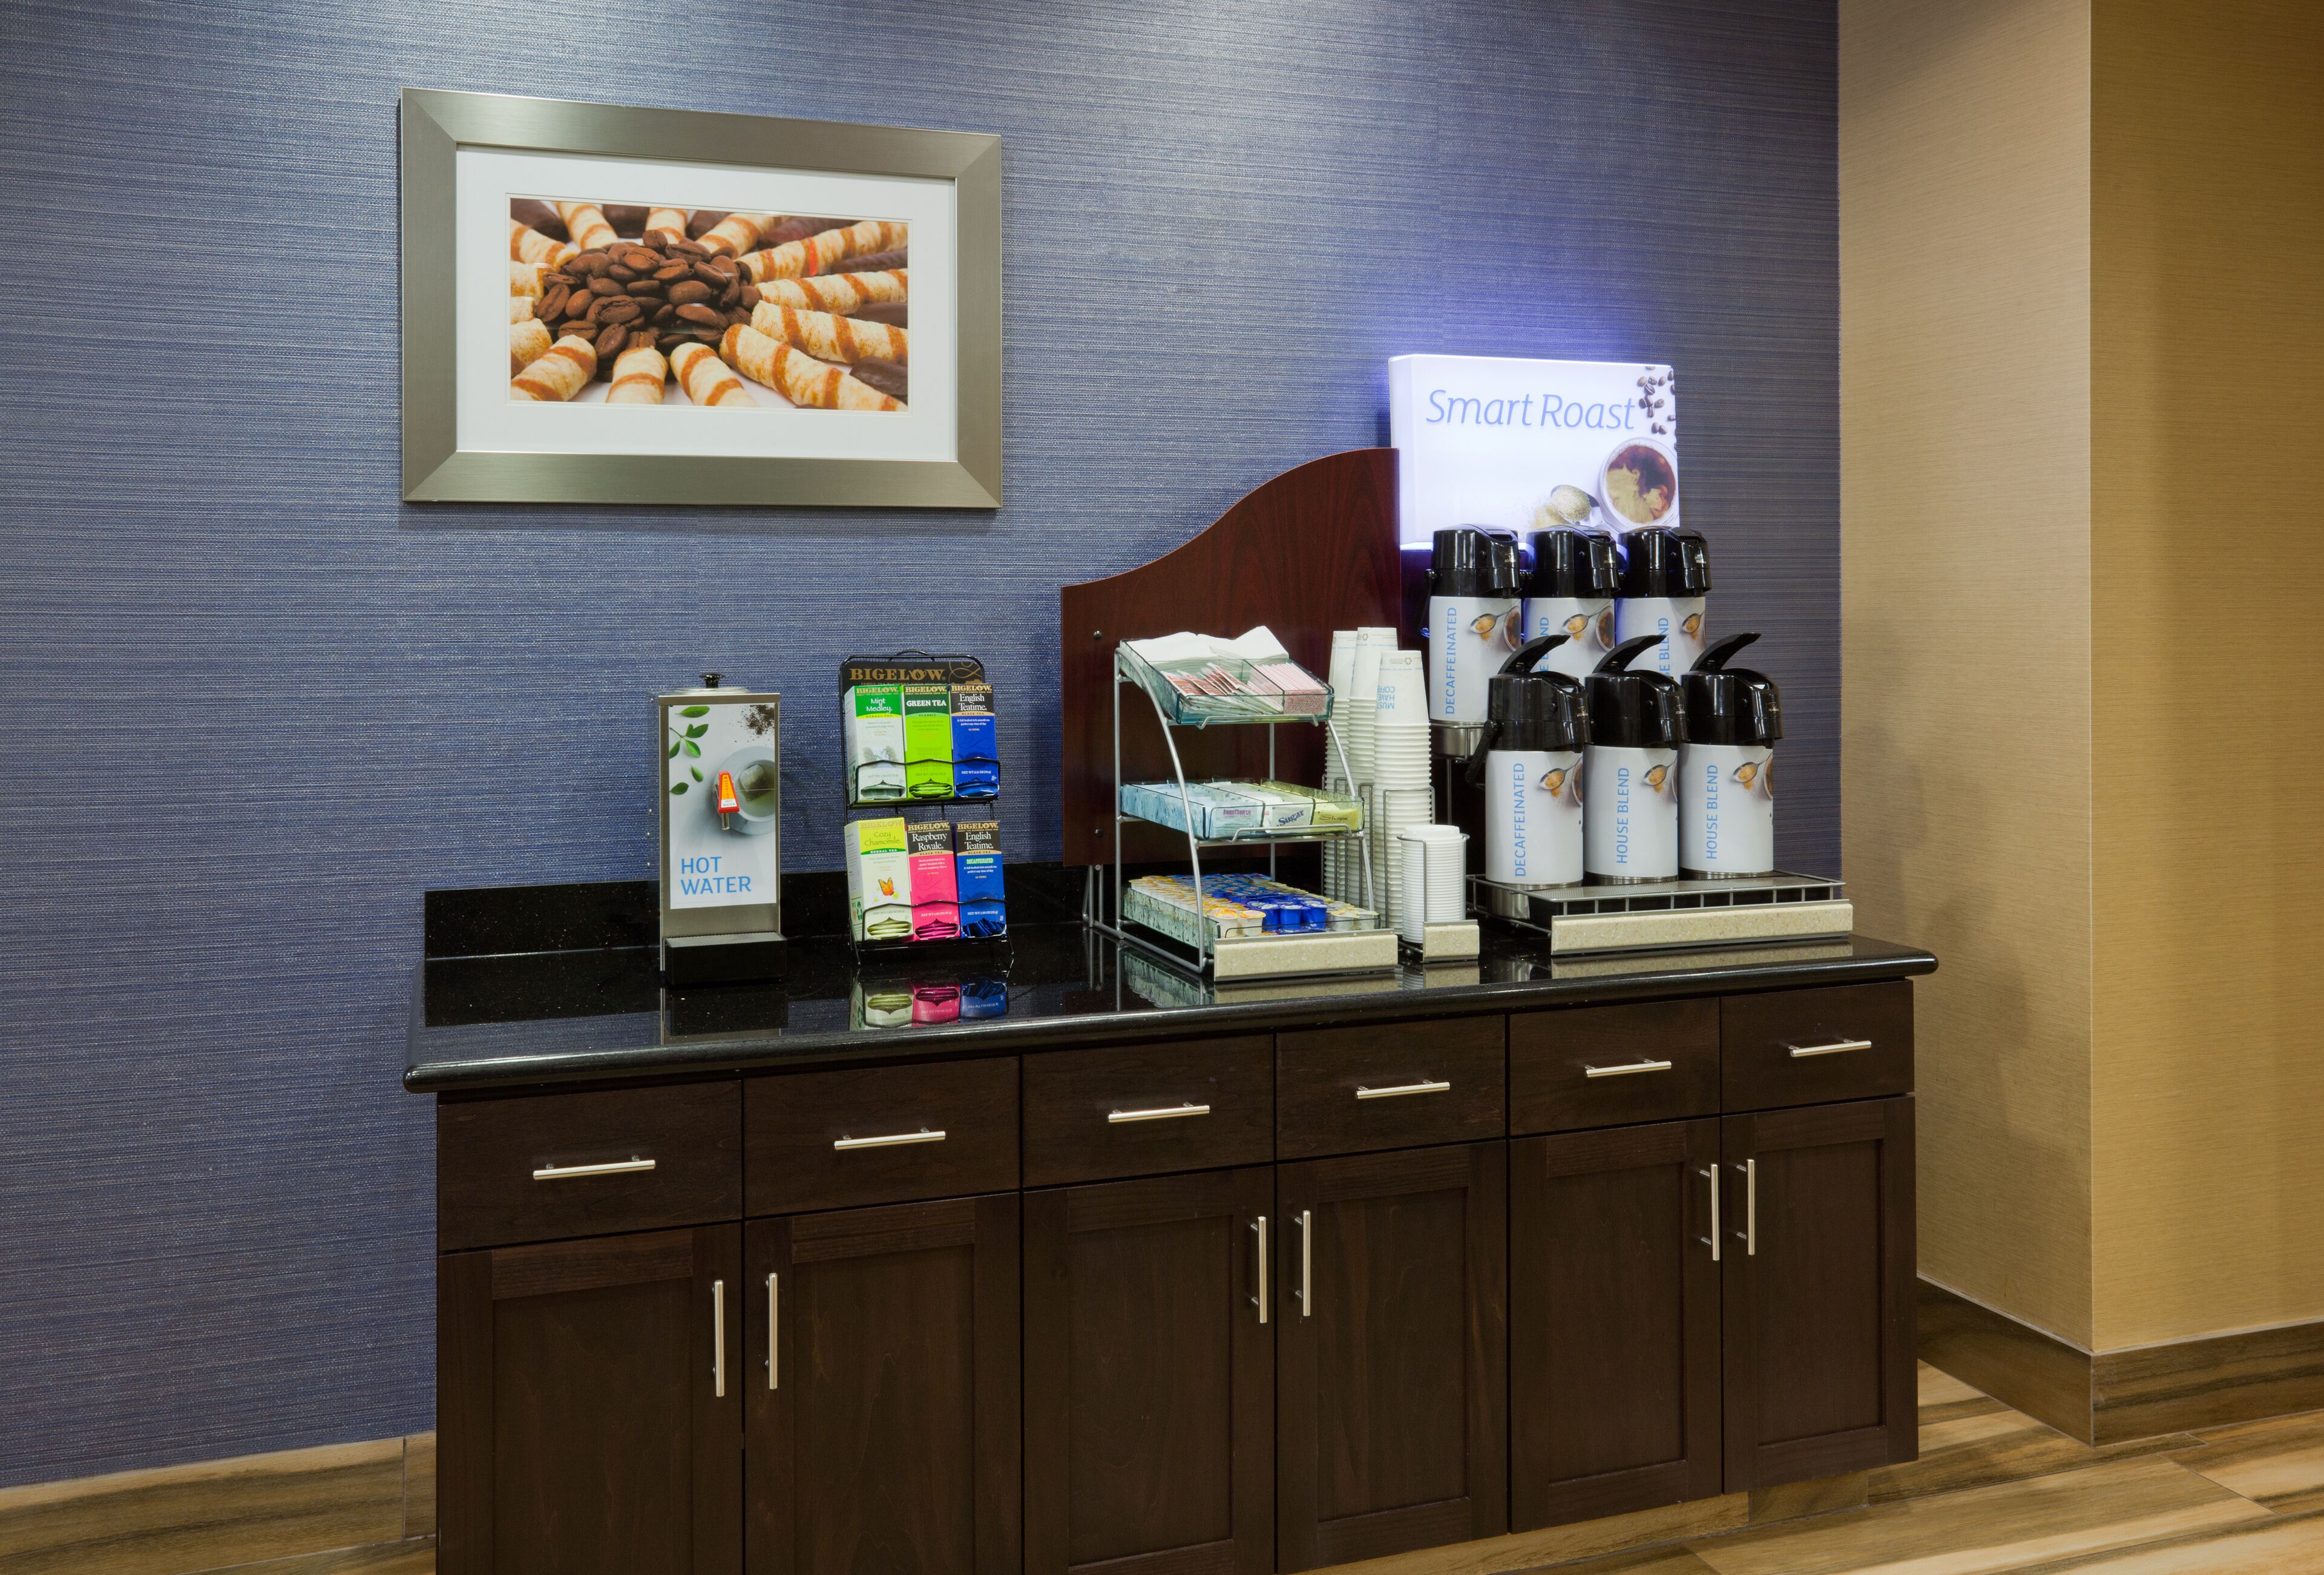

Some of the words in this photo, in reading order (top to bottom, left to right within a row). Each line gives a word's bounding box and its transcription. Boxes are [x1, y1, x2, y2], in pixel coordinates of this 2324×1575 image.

[1426, 389, 1533, 426] Smart
[1540, 394, 1635, 429] Roast
[1445, 607, 1457, 714] DECAFFEINATED
[850, 668, 945, 680] BIGELOW
[959, 694, 985, 703] English
[867, 703, 891, 714] Medley
[1617, 768, 1629, 813] BLEND
[1706, 764, 1718, 809] BLEND
[1278, 810, 1304, 826] Sugar
[1514, 763, 1526, 876] DECAFFEINATED
[907, 822, 950, 831] BIGELOW
[864, 836, 900, 846] Chamomile
[912, 832, 947, 843] Raspberry
[965, 832, 991, 841] English
[1617, 817, 1628, 863] HOUSE
[1705, 814, 1718, 859] HOUSE
[918, 841, 944, 850] Royale
[681, 857, 722, 874] HOT
[680, 876, 752, 895] WATER
